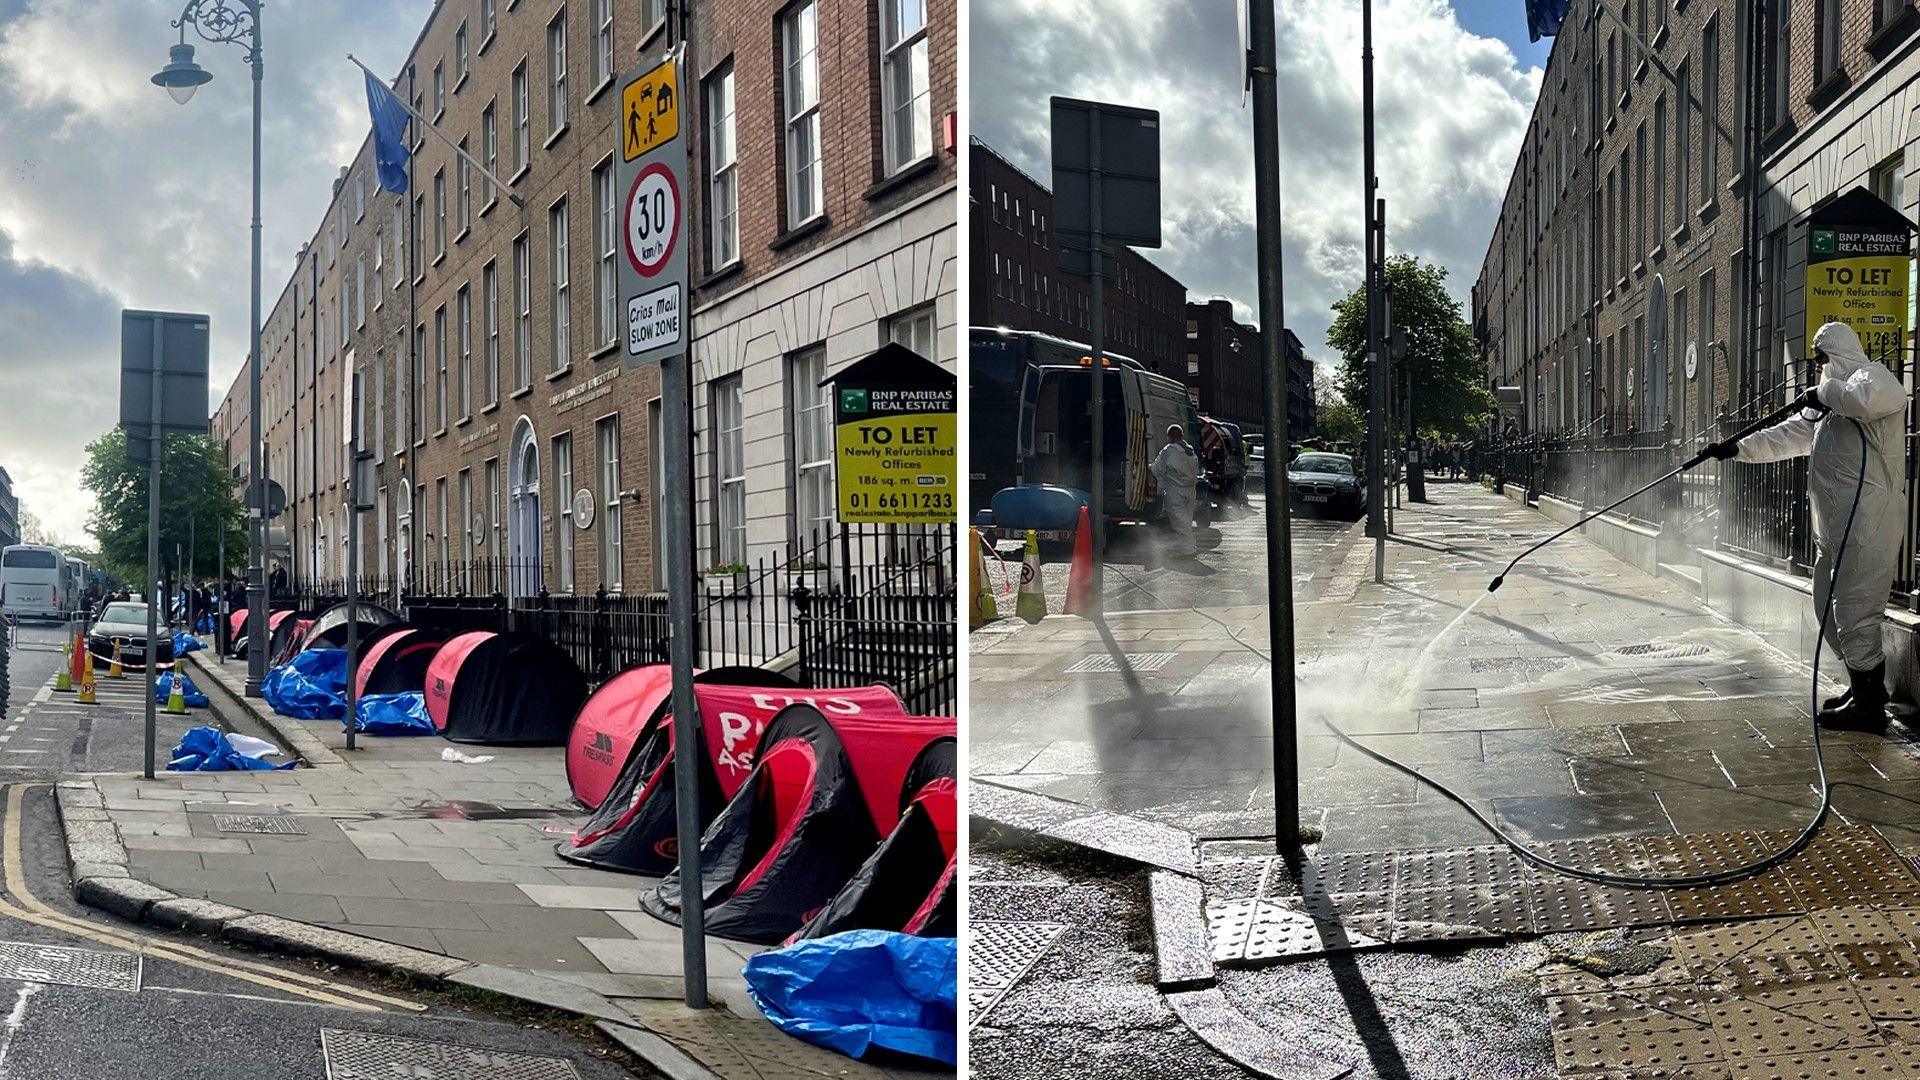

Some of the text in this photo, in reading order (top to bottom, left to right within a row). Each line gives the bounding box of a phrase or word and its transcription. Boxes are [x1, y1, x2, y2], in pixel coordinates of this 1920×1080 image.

[637, 187, 665, 240] 30
[1838, 233, 1906, 243] BNP PARIBAS
[641, 241, 664, 260] km/h
[1838, 243, 1903, 253] REAL ESTATE
[1826, 267, 1892, 286] TO LET
[1813, 287, 1903, 297] Newly Refurbished
[1843, 299, 1876, 309] Offices
[631, 316, 678, 344] SLOW ZONE
[872, 391, 953, 400] BNP PARIBAS
[872, 401, 950, 411] REAL ESTATE
[858, 426, 938, 445] TO LET
[844, 447, 954, 458] Newly Refurbished
[881, 459, 922, 469] Offices
[858, 475, 878, 485] 186
[850, 492, 953, 508] 01 6611233
